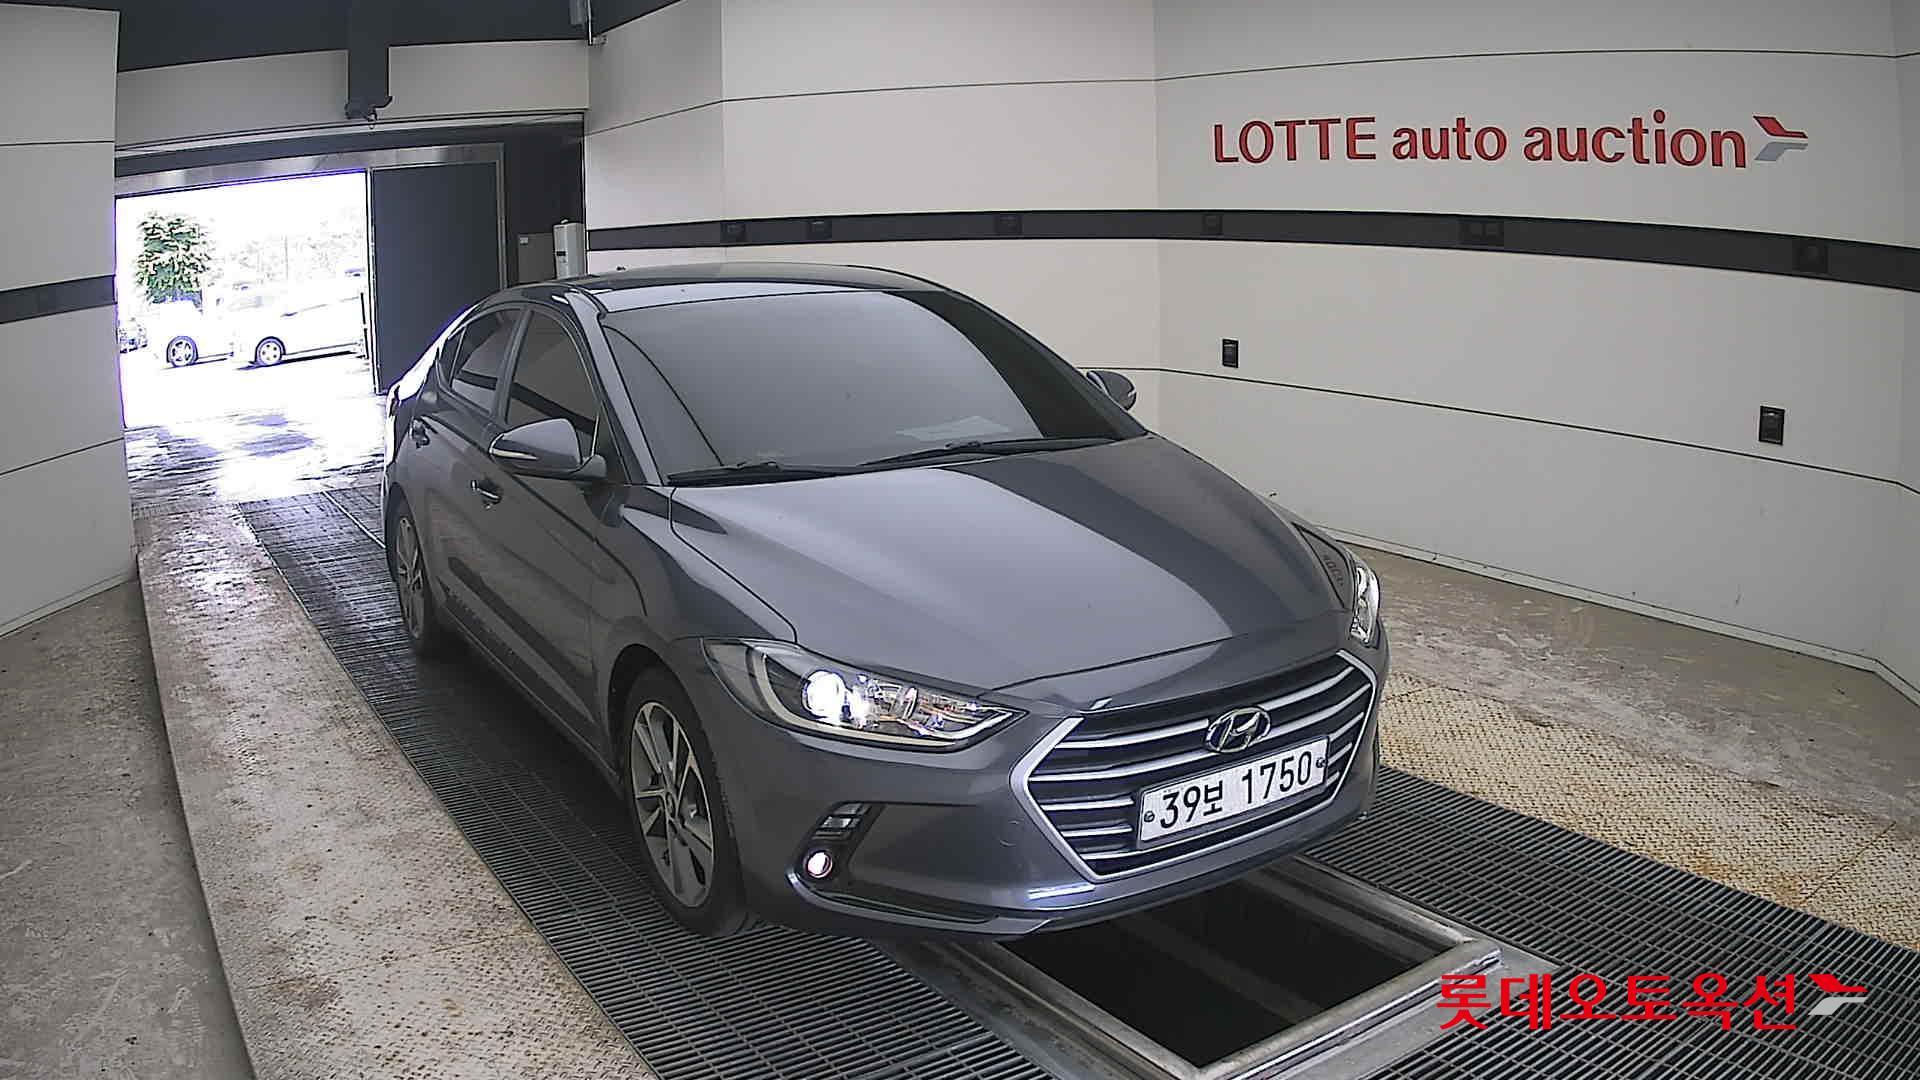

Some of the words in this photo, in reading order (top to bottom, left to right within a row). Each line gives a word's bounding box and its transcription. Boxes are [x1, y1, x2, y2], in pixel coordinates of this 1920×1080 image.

[1213, 116, 1376, 163] LOTTE
[1392, 118, 1508, 161] auto
[1523, 109, 1746, 168] auction
[1159, 780, 1223, 829] 39보
[1241, 751, 1312, 804] 1750
